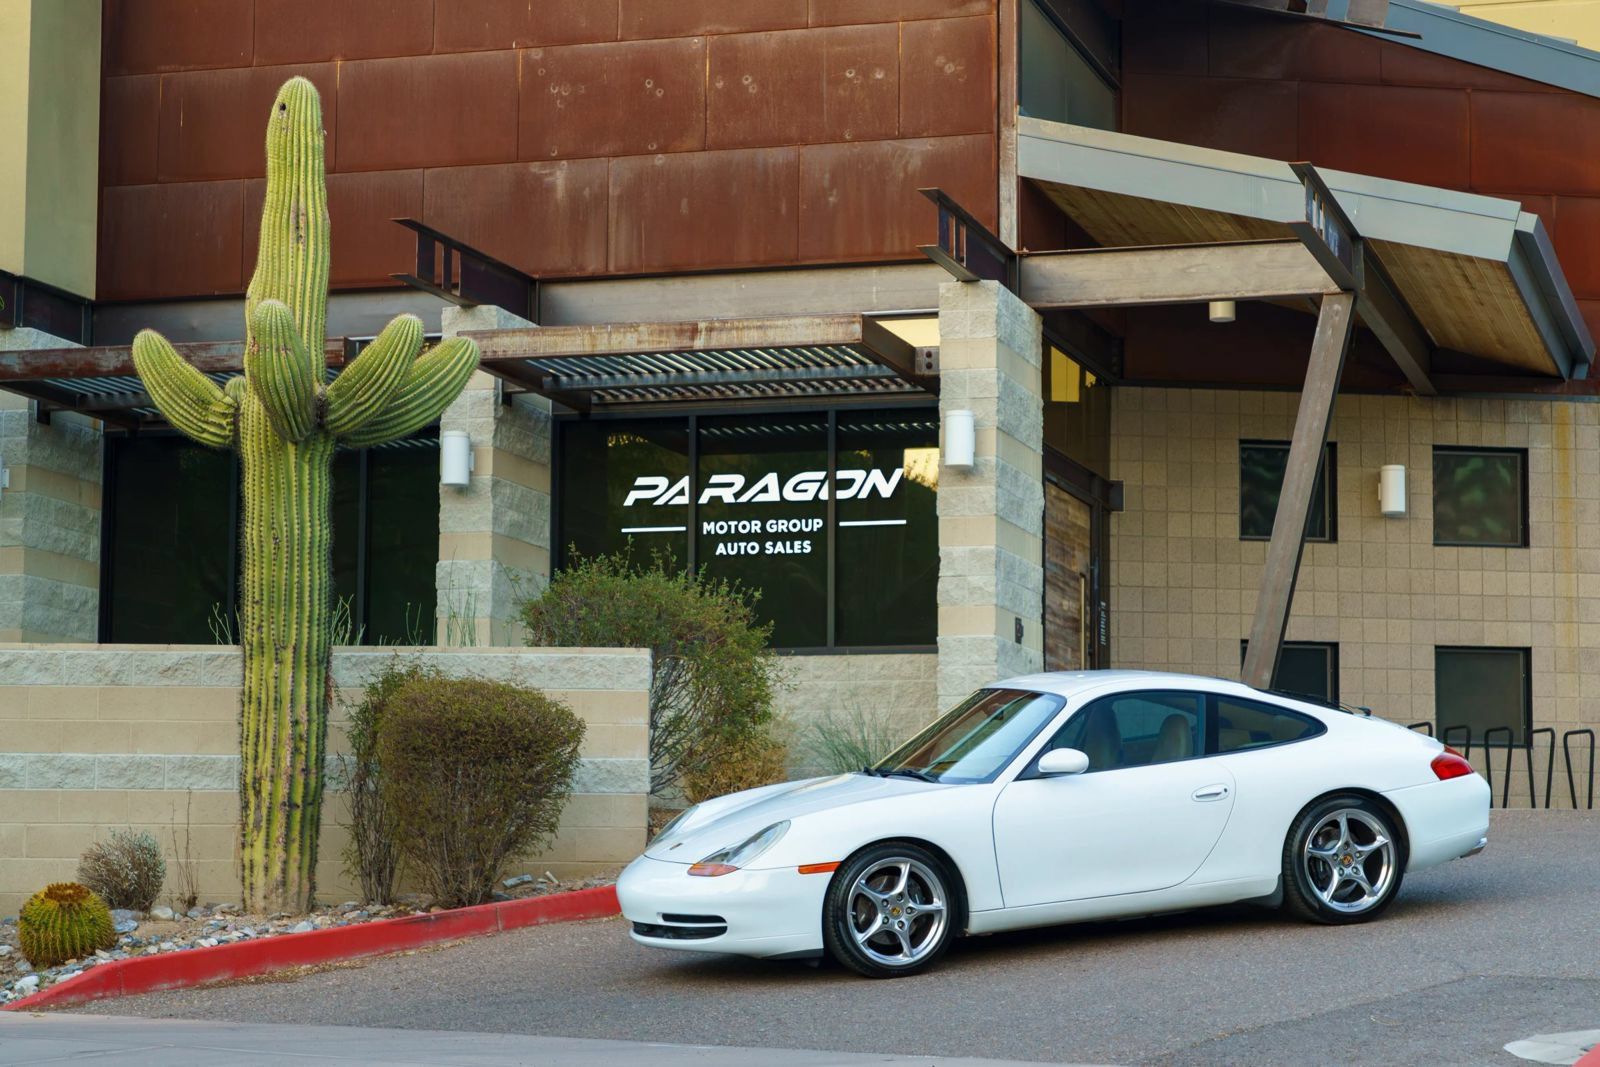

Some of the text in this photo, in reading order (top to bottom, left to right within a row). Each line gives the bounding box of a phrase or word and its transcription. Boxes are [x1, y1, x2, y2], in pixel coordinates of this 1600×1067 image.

[623, 468, 904, 506] PARAGON
[702, 518, 823, 535] MOTOR GROUP
[715, 540, 812, 556] AUTO SALES
